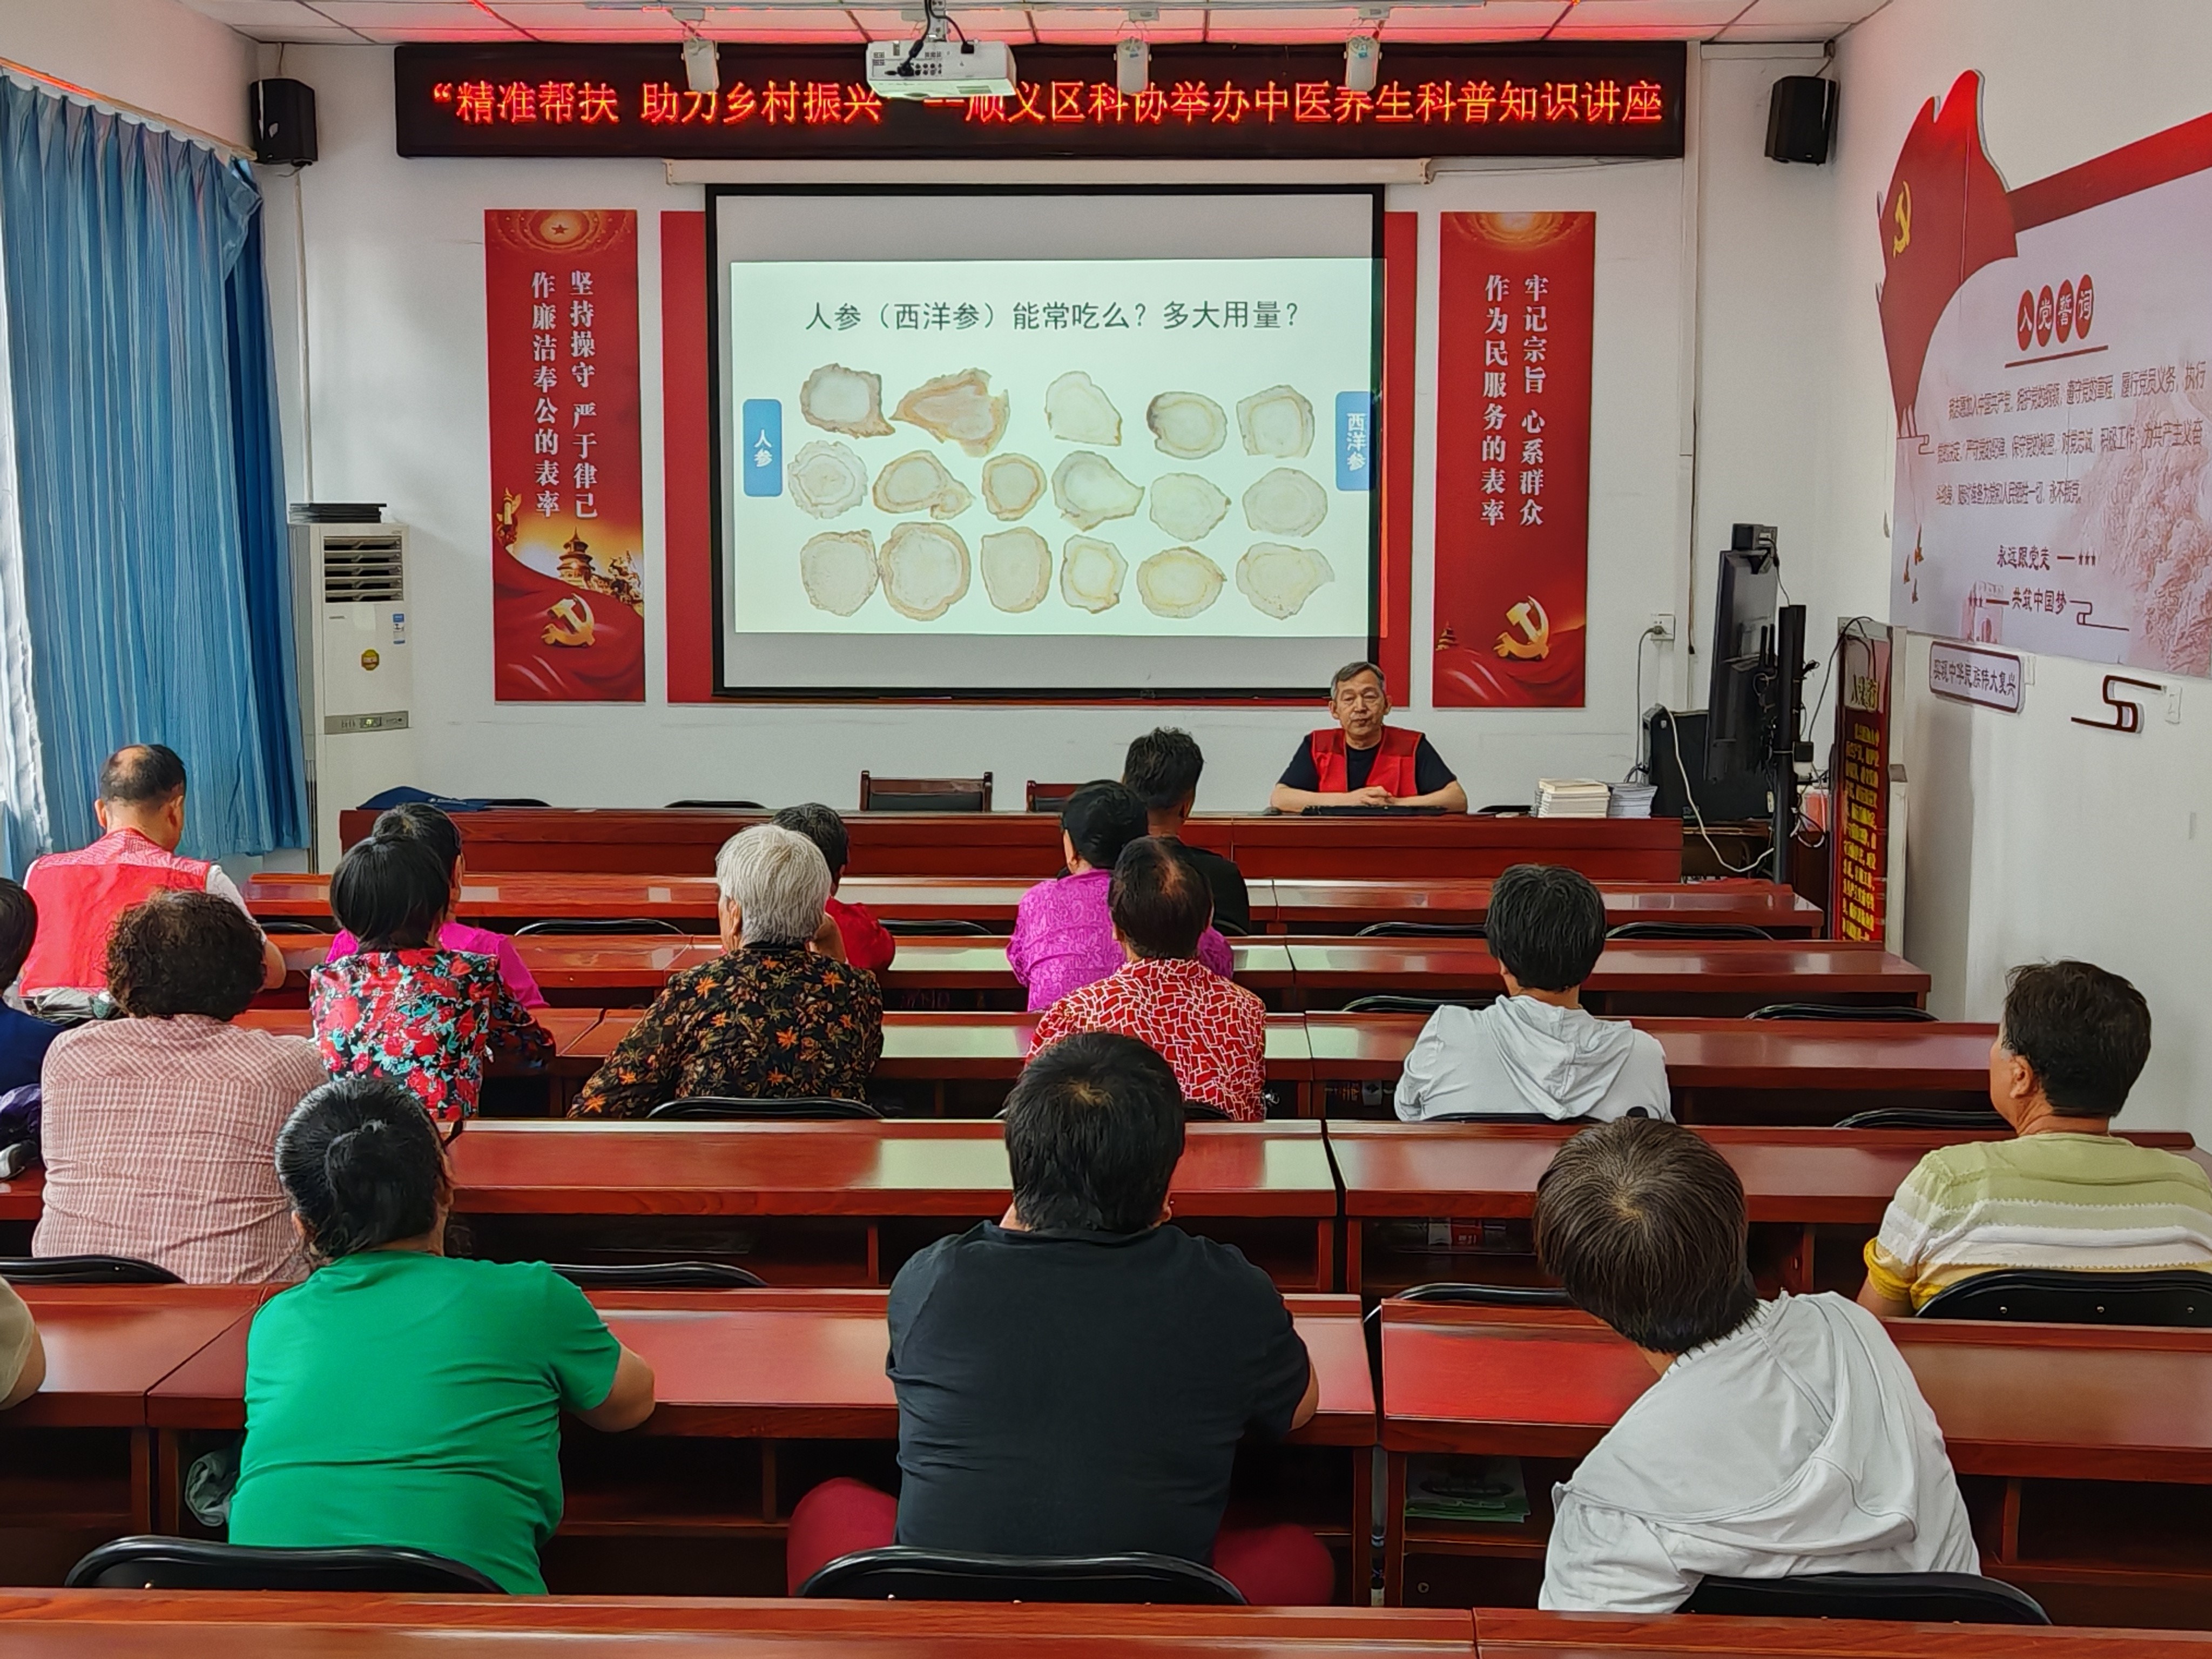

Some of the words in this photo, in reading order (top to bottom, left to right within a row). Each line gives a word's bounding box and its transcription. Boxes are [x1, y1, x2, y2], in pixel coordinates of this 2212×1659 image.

[433, 81, 618, 123] “精准帮扶
[569, 270, 595, 388] 坚持操守
[1522, 274, 1549, 394] 牢记宗旨
[2019, 288, 2094, 333] 入党誓词
[531, 271, 561, 518] 作廉洁奉公的表率
[1480, 274, 1510, 527] 作为民服务的表率
[572, 402, 598, 518] 严于律己
[754, 429, 772, 468] 人参
[1346, 412, 1367, 471] 西洋参
[1519, 409, 1545, 526] 心系群众
[1997, 545, 2051, 570] 永远跟党走
[2011, 586, 2067, 615] 共筑中国梦
